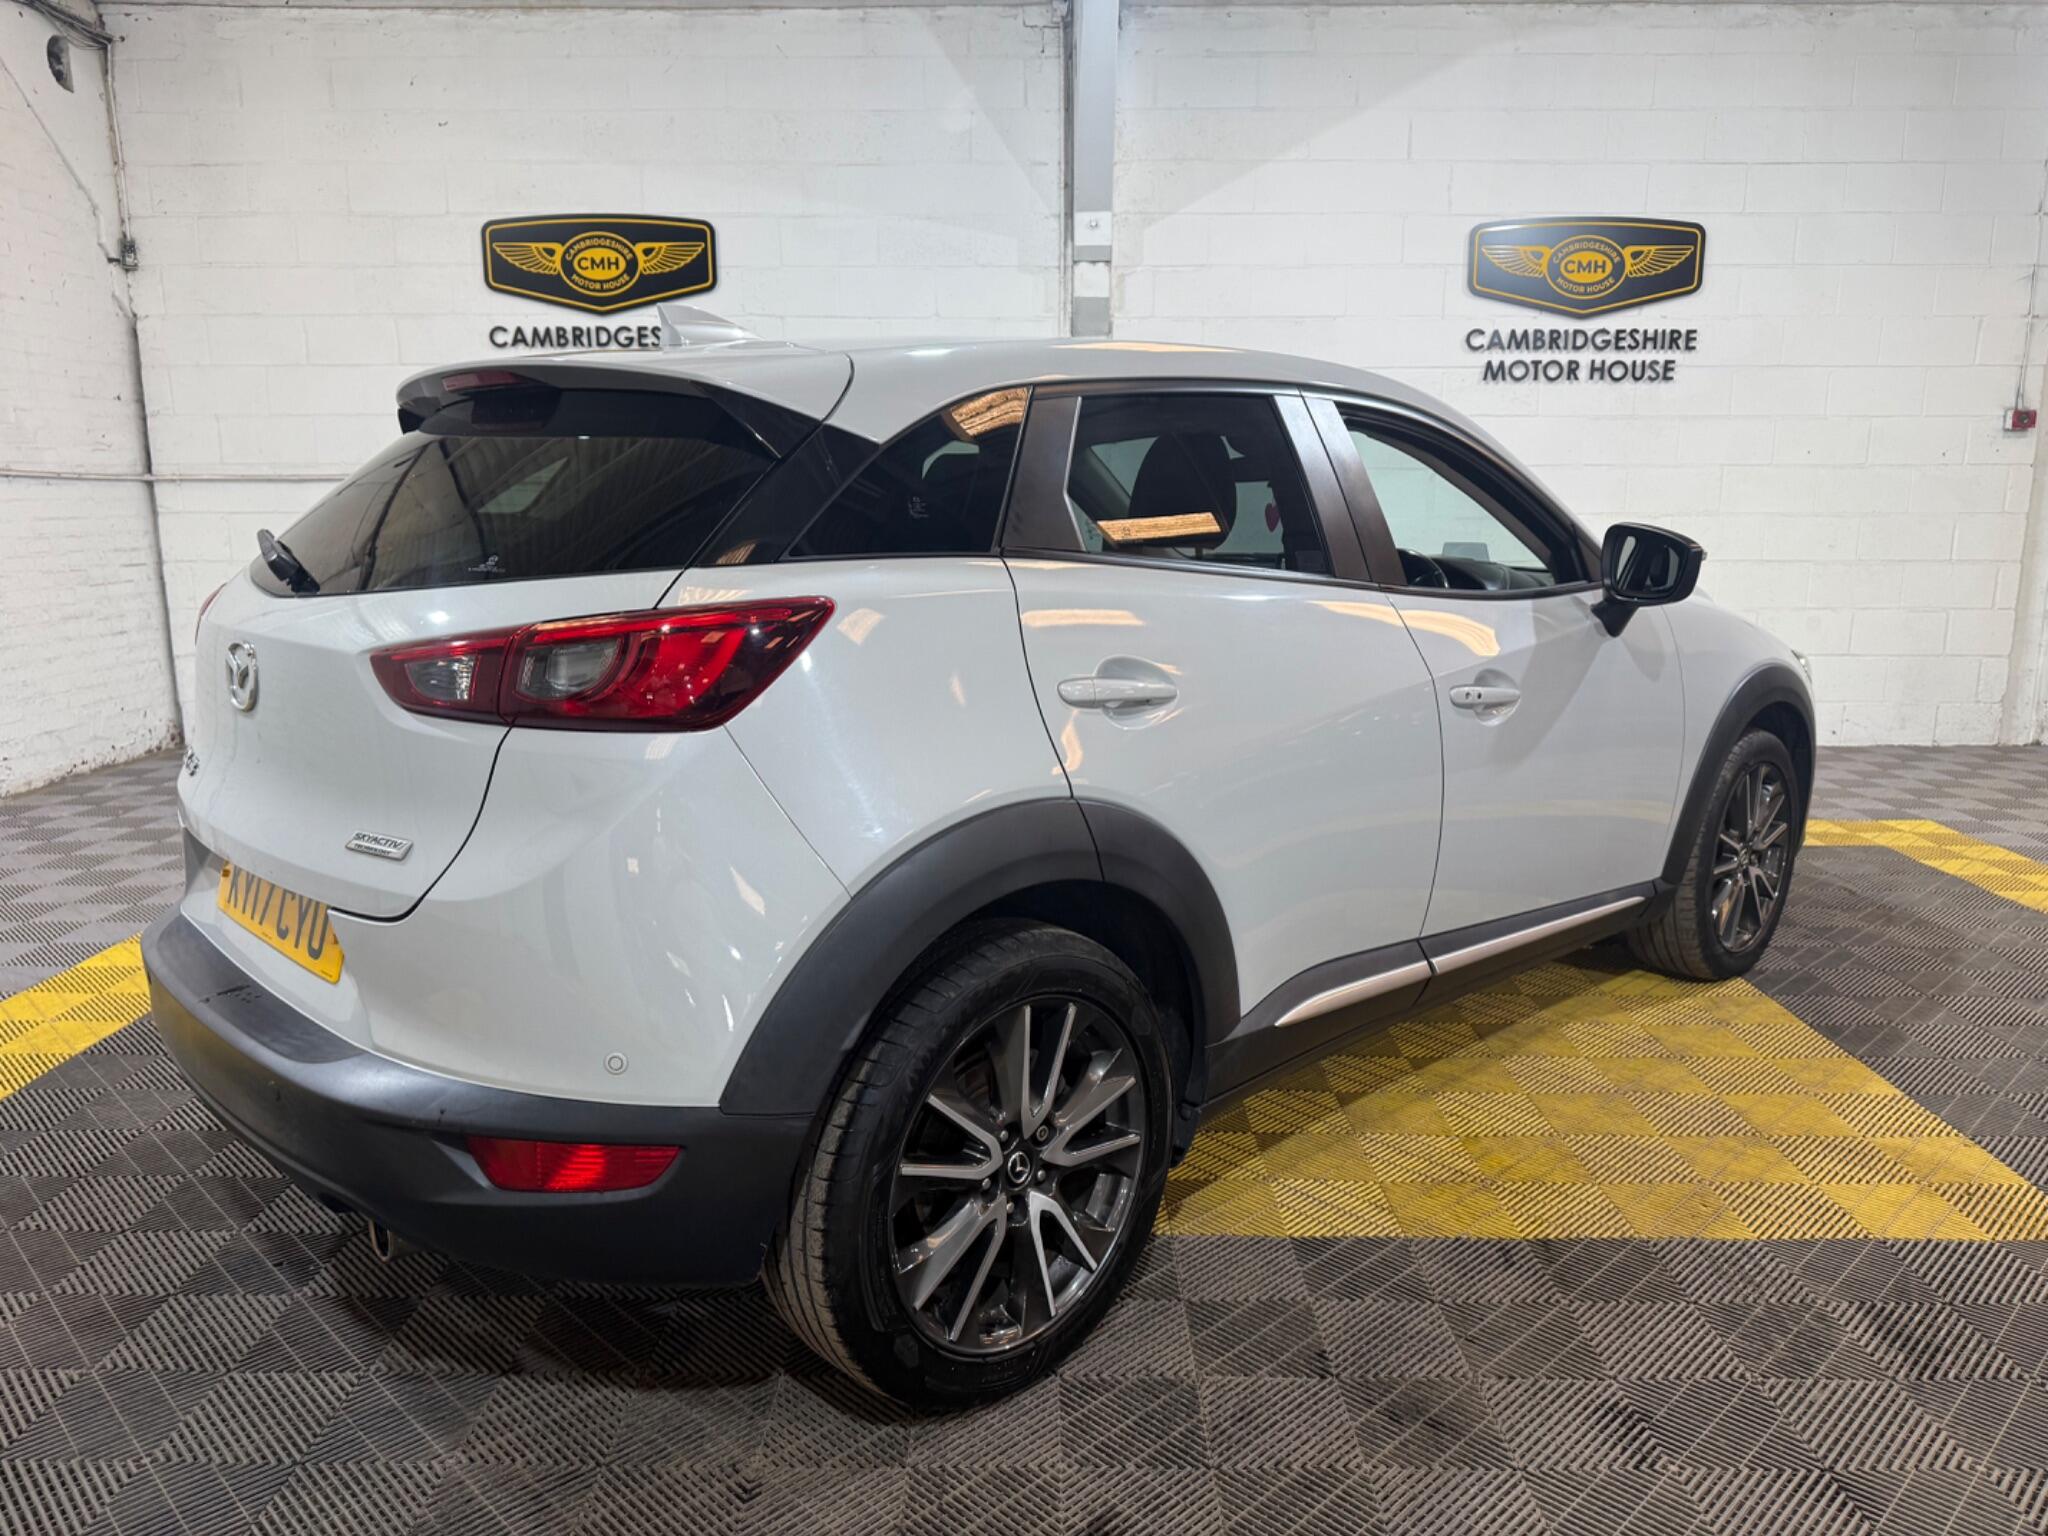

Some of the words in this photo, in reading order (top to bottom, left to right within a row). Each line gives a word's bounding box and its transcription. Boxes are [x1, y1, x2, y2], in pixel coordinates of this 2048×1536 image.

[565, 238, 634, 261] CAMBRIDGESHIRE
[1552, 241, 1621, 264] CAMBRIDGESHIRE
[577, 256, 620, 271] CMH
[1564, 259, 1607, 274] CMH
[571, 273, 601, 290] MOTOR
[602, 273, 630, 290] HOUSE
[1556, 277, 1586, 293] MOTOR
[1587, 276, 1616, 293] HOUSE
[1465, 328, 1698, 351] CAMBRIDGESHIRE
[1482, 359, 1580, 382] MOTOR
[1589, 359, 1677, 382] HOUSE
